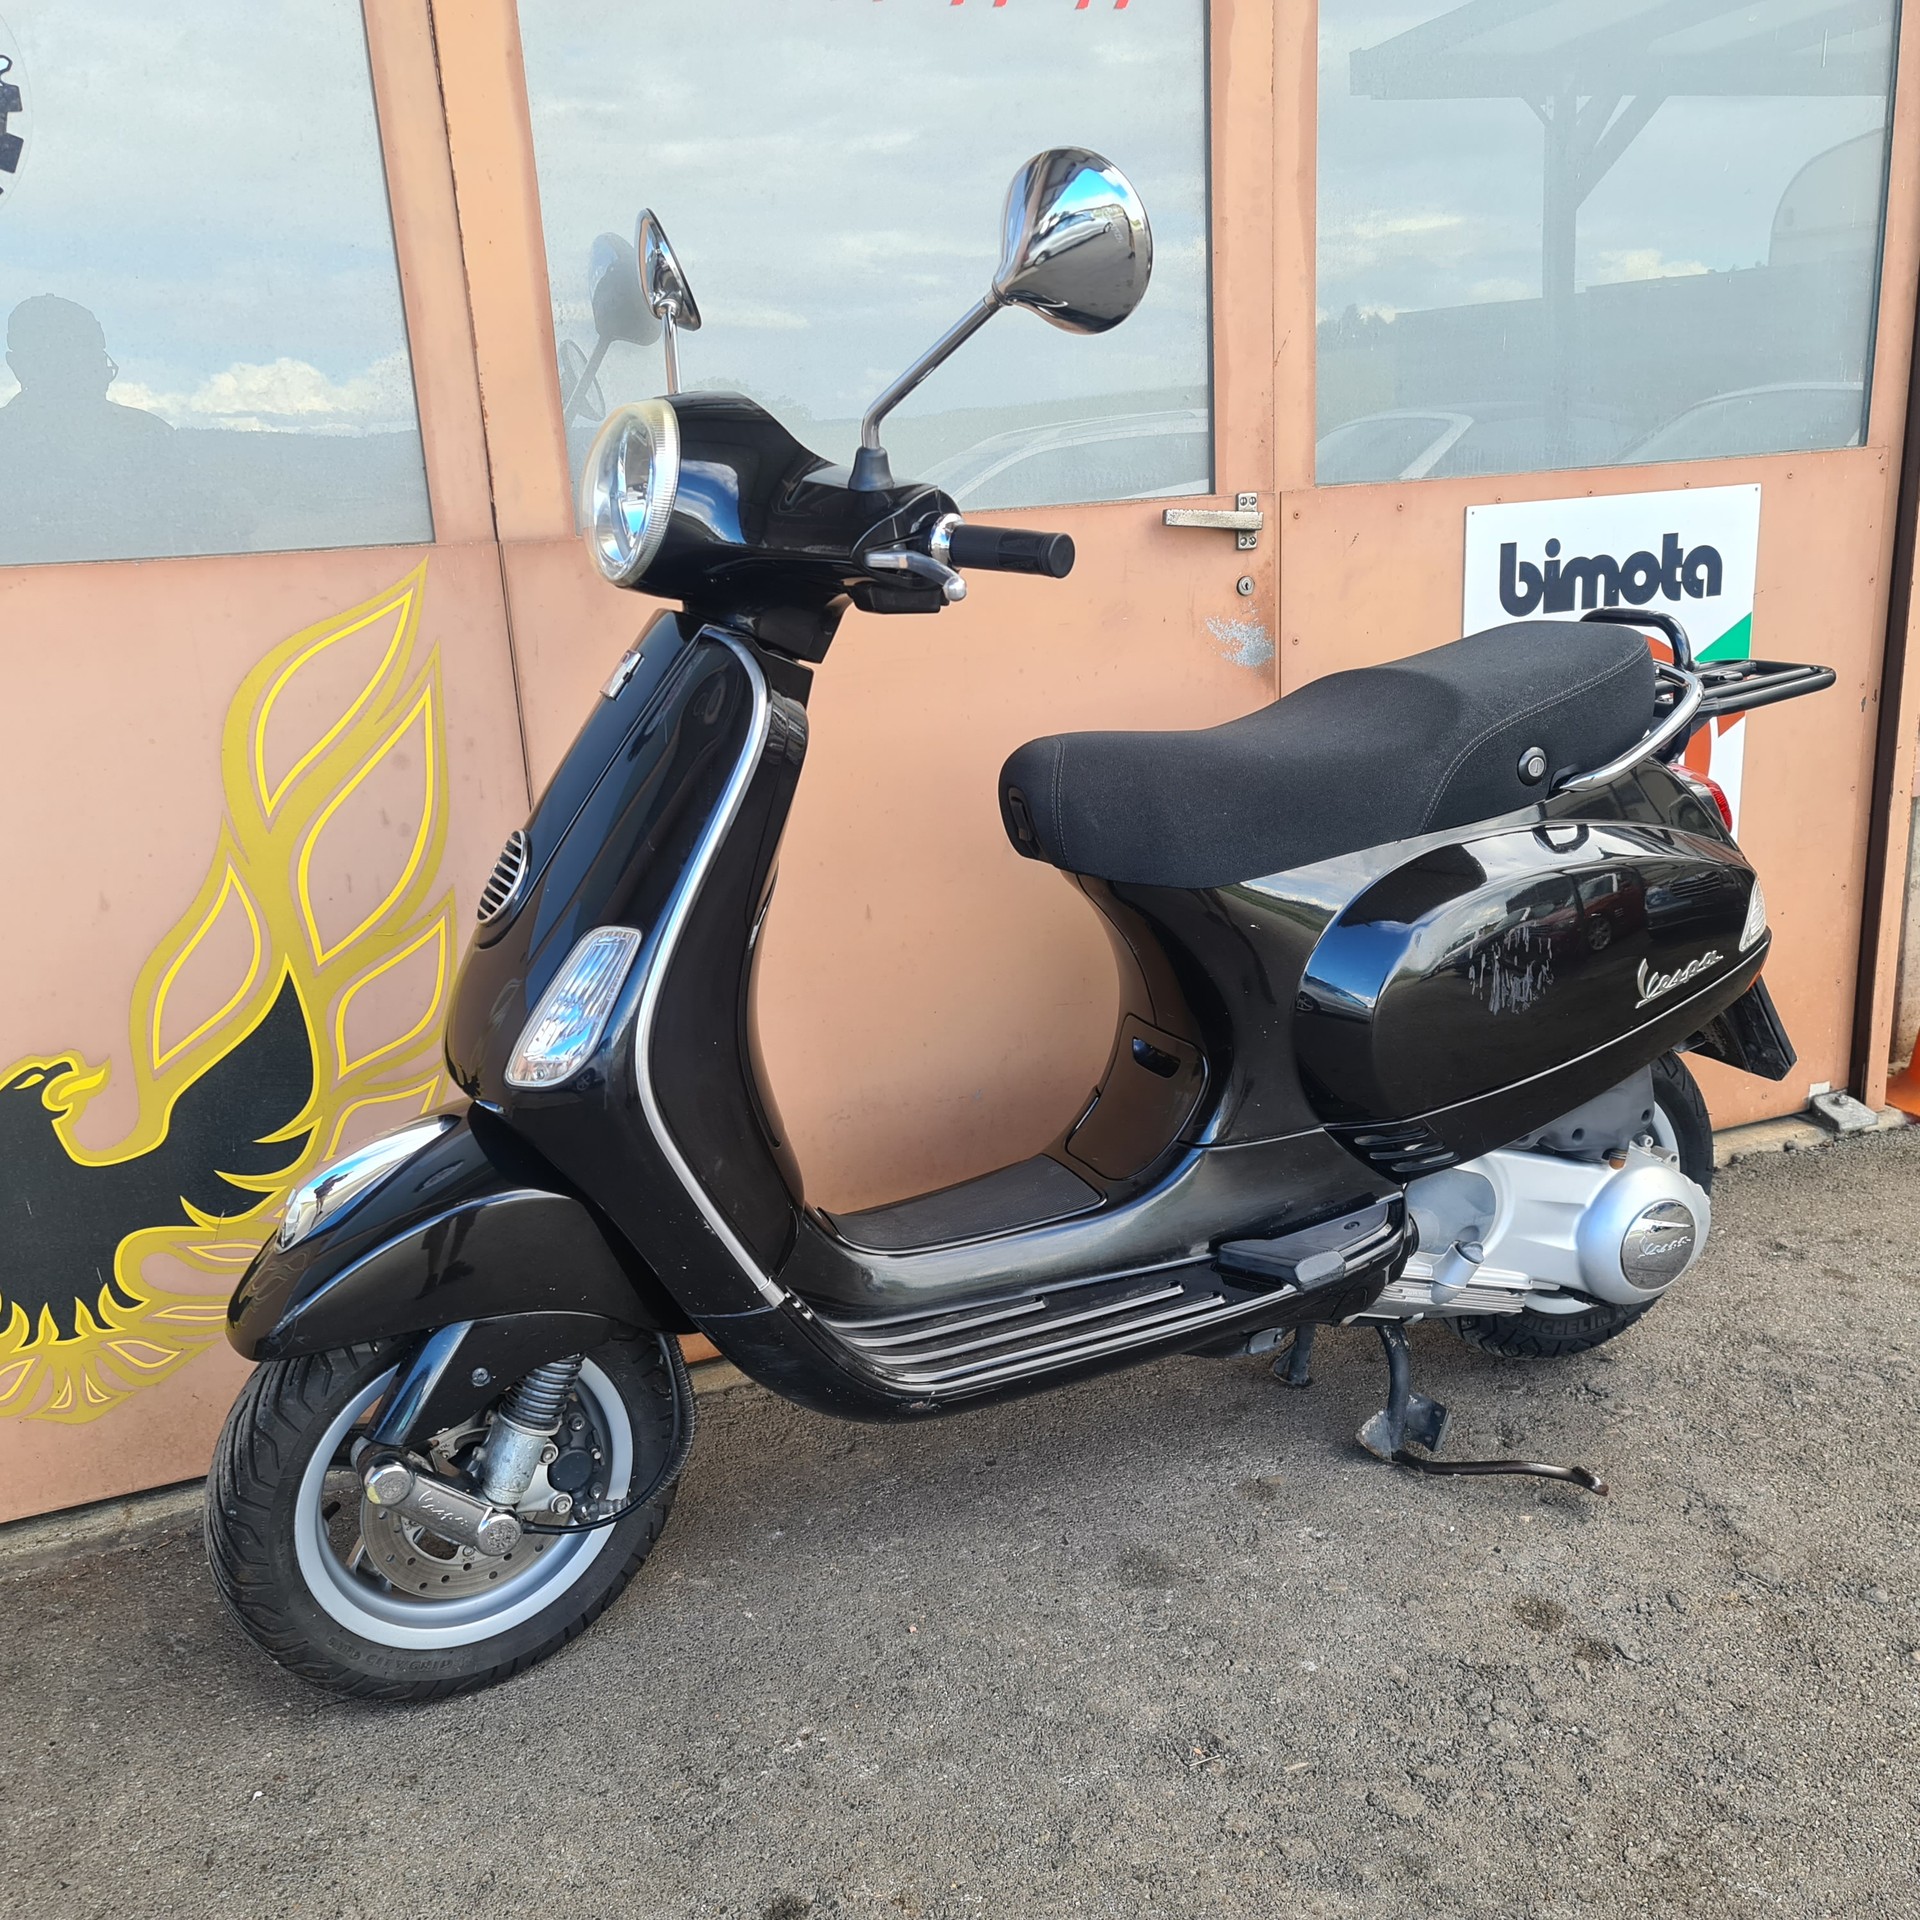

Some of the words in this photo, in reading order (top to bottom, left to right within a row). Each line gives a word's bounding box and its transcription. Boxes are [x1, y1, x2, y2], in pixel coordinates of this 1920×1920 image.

[1499, 533, 1723, 617] bimota
[1635, 950, 1724, 1009] Vespa
[1637, 1235, 1692, 1259] Vespa
[1519, 1311, 1612, 1335] MICHELIN
